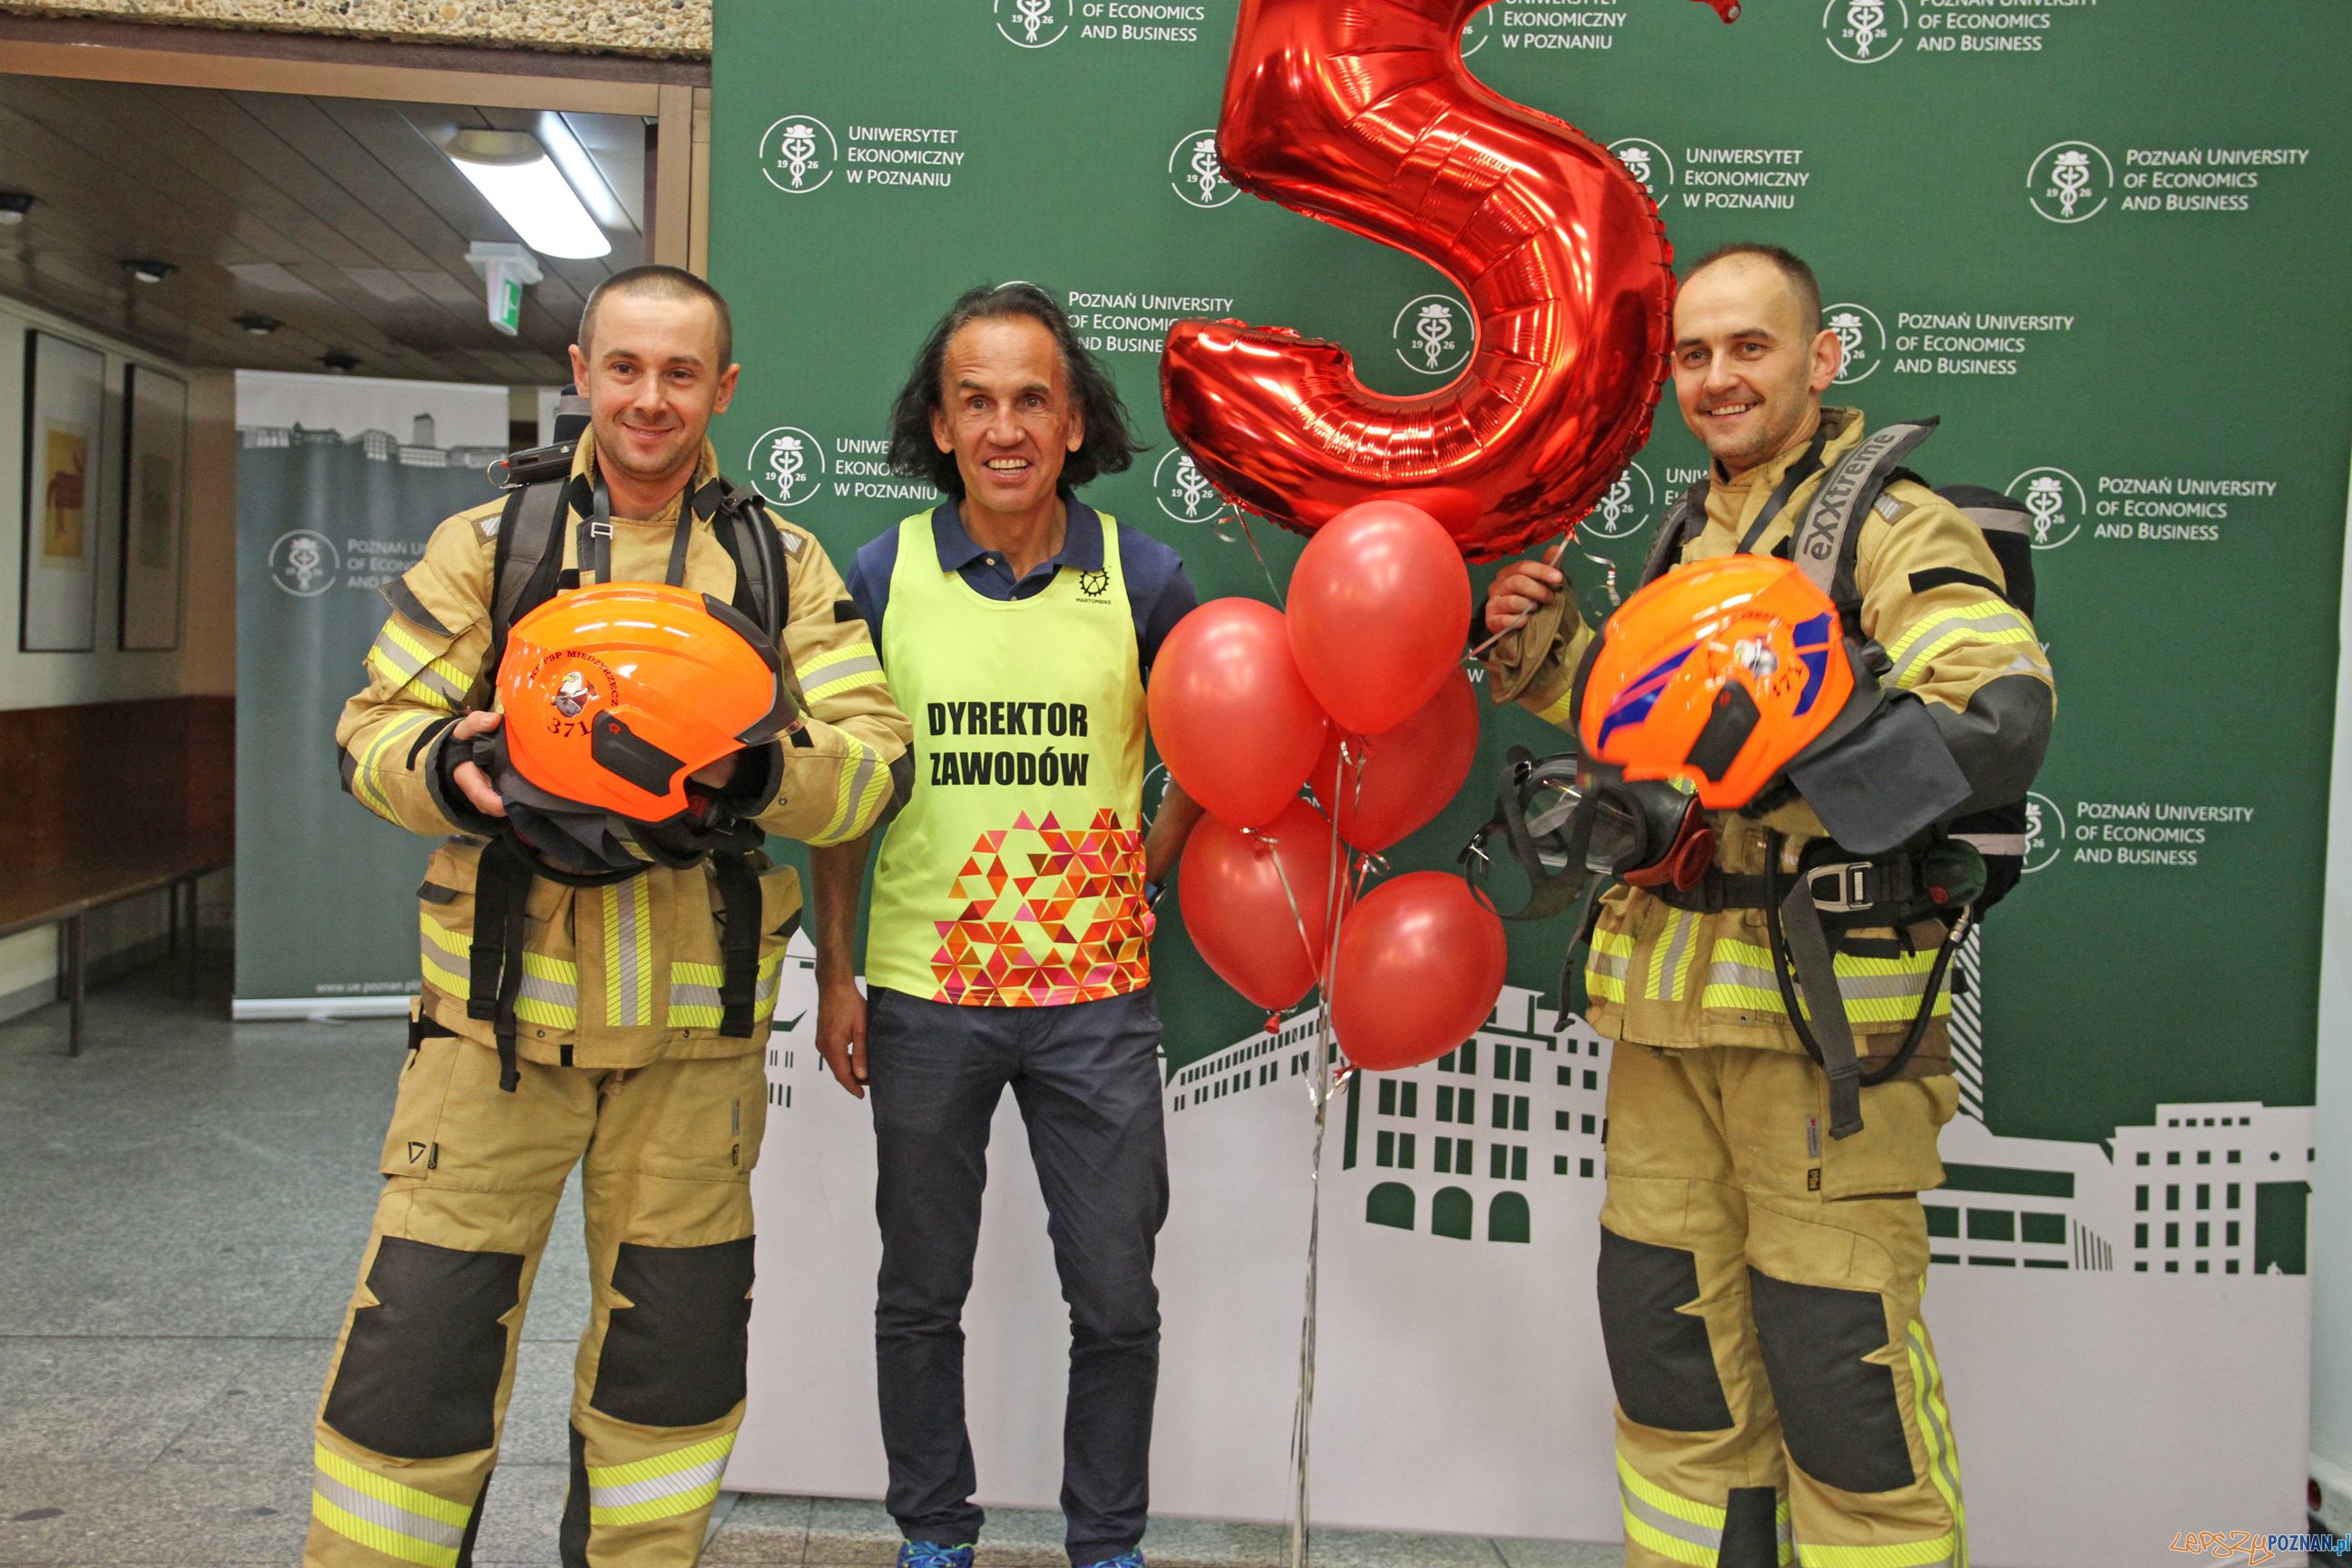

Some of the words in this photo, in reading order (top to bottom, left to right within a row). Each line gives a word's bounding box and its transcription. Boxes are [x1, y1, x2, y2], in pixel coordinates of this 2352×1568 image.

[1012, 15, 1023, 23] 19
[1042, 15, 1054, 24] 26
[1082, 3, 1105, 17] OF
[1108, 2, 1205, 21] ECONOMICS
[1504, 10, 1628, 27] EKONOMICZNY
[1917, 14, 1942, 29] OF
[1946, 12, 2051, 29] ECONOMICS
[1081, 24, 1118, 39] AND
[1122, 24, 1198, 42] BUSINESS
[1502, 34, 1521, 48] W
[1524, 33, 1612, 50] POZNANIU
[1842, 28, 1855, 38] 19
[1874, 28, 1888, 38] 26
[1916, 36, 1956, 52] AND
[1960, 34, 2043, 52] BUSINESS
[848, 125, 958, 143] UNIWERSYTET
[778, 160, 789, 169] 19
[807, 161, 818, 170] 26
[848, 146, 965, 166] EKONOMICZNY
[1686, 147, 1804, 165] UNIWERSYTET
[2126, 147, 2202, 166] POZNAŃ
[2207, 148, 2310, 166] UNIVERSITY
[846, 169, 864, 183] W
[867, 169, 952, 187] POZNANIU
[1186, 173, 1199, 183] 19
[1684, 169, 1810, 187] EKONOMICZNY
[2124, 172, 2147, 188] OF
[2151, 171, 2259, 189] ECONOMICS
[1682, 192, 1701, 208] W
[1704, 191, 1795, 210] POZNANIU
[2046, 188, 2059, 198] 19
[2079, 188, 2092, 198] 26
[2121, 195, 2162, 211] AND
[2165, 193, 2249, 211] BUSINESS
[1068, 290, 1137, 309] POZNAŃ
[1142, 293, 1234, 312] UNIVERSITY
[1067, 314, 1089, 328] OF
[1093, 313, 1179, 332] ECONOMI
[1897, 311, 1972, 329] POZNAŃ
[1975, 313, 2075, 331] UNIVERSITY
[1074, 336, 1102, 351] ND
[1106, 335, 1163, 353] BUSINE
[1411, 339, 1424, 349] 19
[1443, 340, 1455, 350] 26
[1896, 336, 1919, 351] OF
[1923, 335, 2025, 353] ECONOMICS
[1852, 349, 1866, 359] 26
[1893, 358, 1933, 374] AND
[1936, 357, 2017, 375] BUSINESS
[765, 471, 777, 481] 19
[794, 472, 807, 482] 26
[833, 482, 851, 496] W
[854, 482, 938, 501] POZNANIU
[1171, 488, 1183, 497] 19
[1201, 489, 1214, 499] 26
[2098, 476, 2172, 495] POZNAŃ
[2177, 478, 2278, 496] UNIVERSITY
[1622, 504, 1634, 514] 26
[2095, 500, 2120, 516] OF
[2123, 499, 2228, 519] ECONOMICS
[2053, 514, 2066, 524] 26
[2093, 523, 2134, 539] AND
[2137, 522, 2220, 541] BUSINESS
[543, 652, 563, 665] PSP
[1466, 668, 1485, 683] W
[547, 717, 593, 737] 371
[927, 701, 1088, 737] DYREKTOR
[929, 746, 1089, 786] ZAWODÓW
[2077, 801, 2151, 820] POZNAŃ
[2155, 803, 2254, 822] UNIVERSITY
[2032, 838, 2045, 848] 26
[2075, 825, 2099, 841] OF
[2102, 824, 2206, 844] ECONOMICS
[2073, 848, 2113, 864] AND
[2117, 847, 2198, 866] BUSINESS
